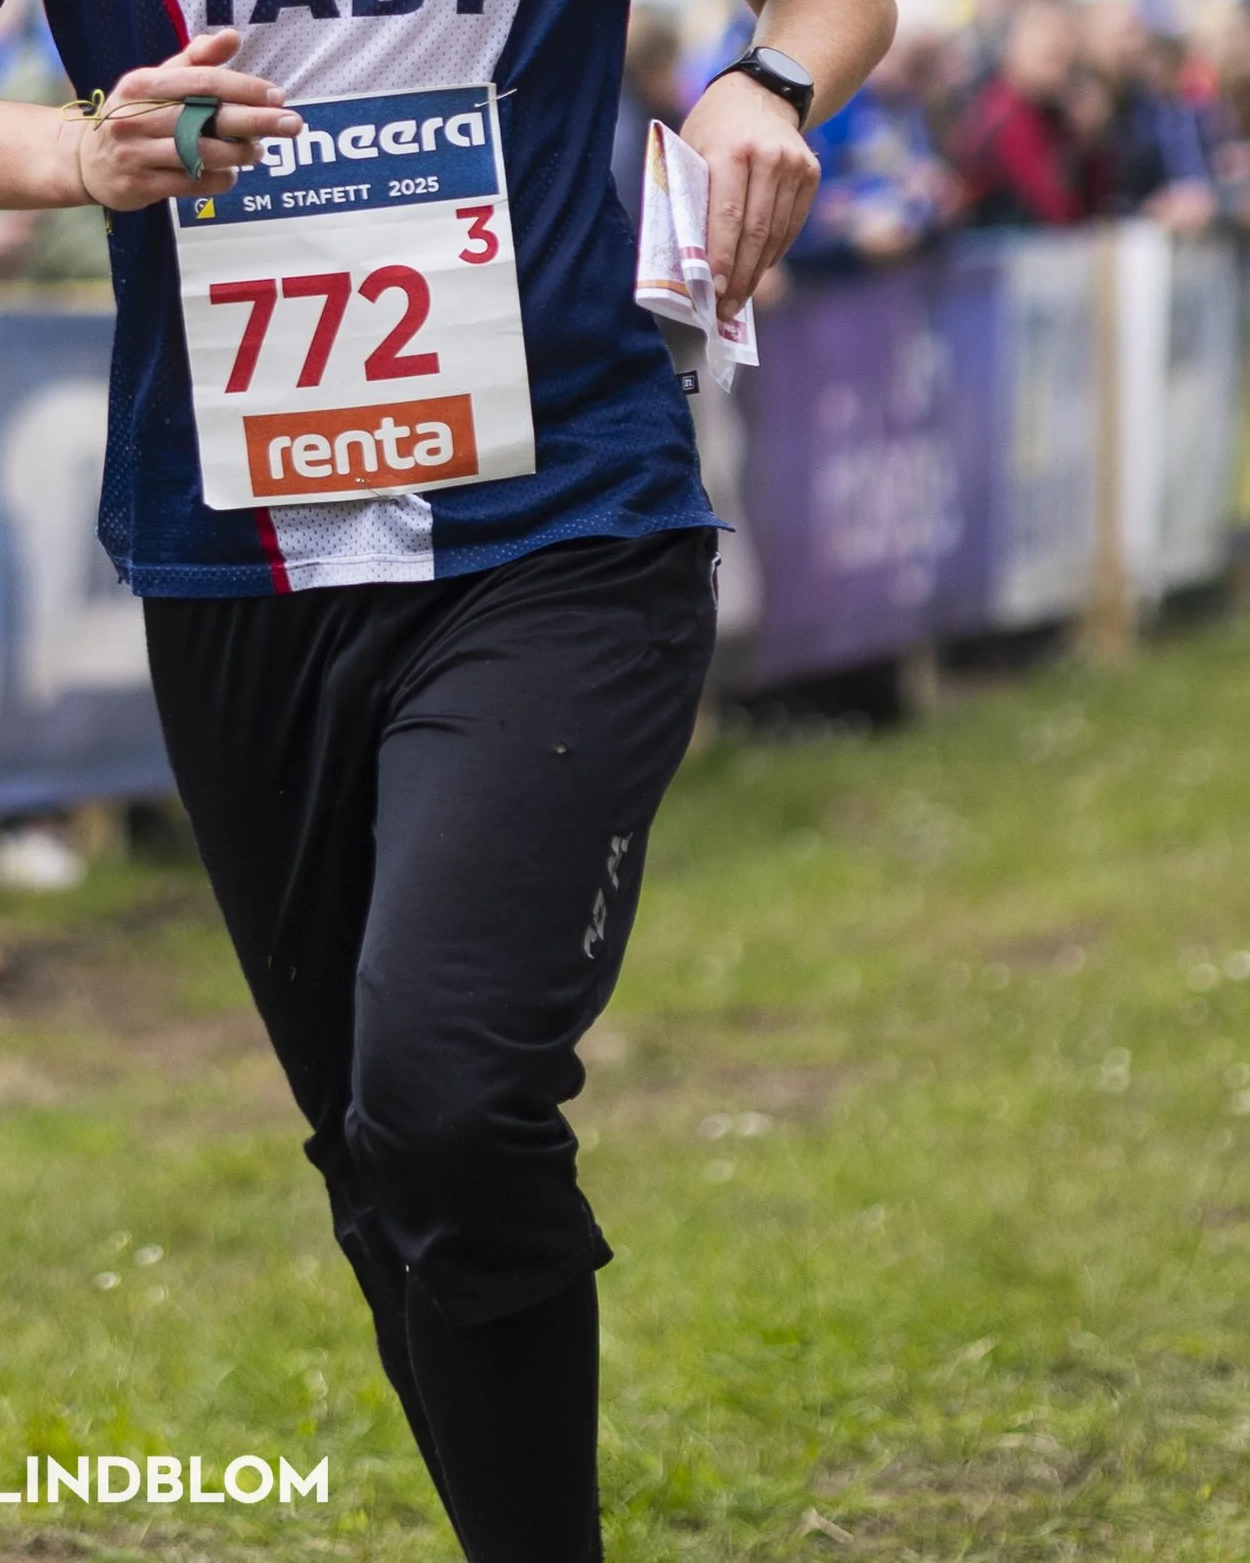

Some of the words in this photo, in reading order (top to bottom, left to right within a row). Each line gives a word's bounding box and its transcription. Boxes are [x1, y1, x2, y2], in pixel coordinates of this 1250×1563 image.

[229, 111, 486, 177] gheera
[242, 194, 273, 213] SM
[281, 183, 371, 209] STAFETT
[388, 176, 440, 198] 2025
[455, 204, 500, 265] 3
[208, 264, 441, 394] 772
[267, 416, 455, 480] renta
